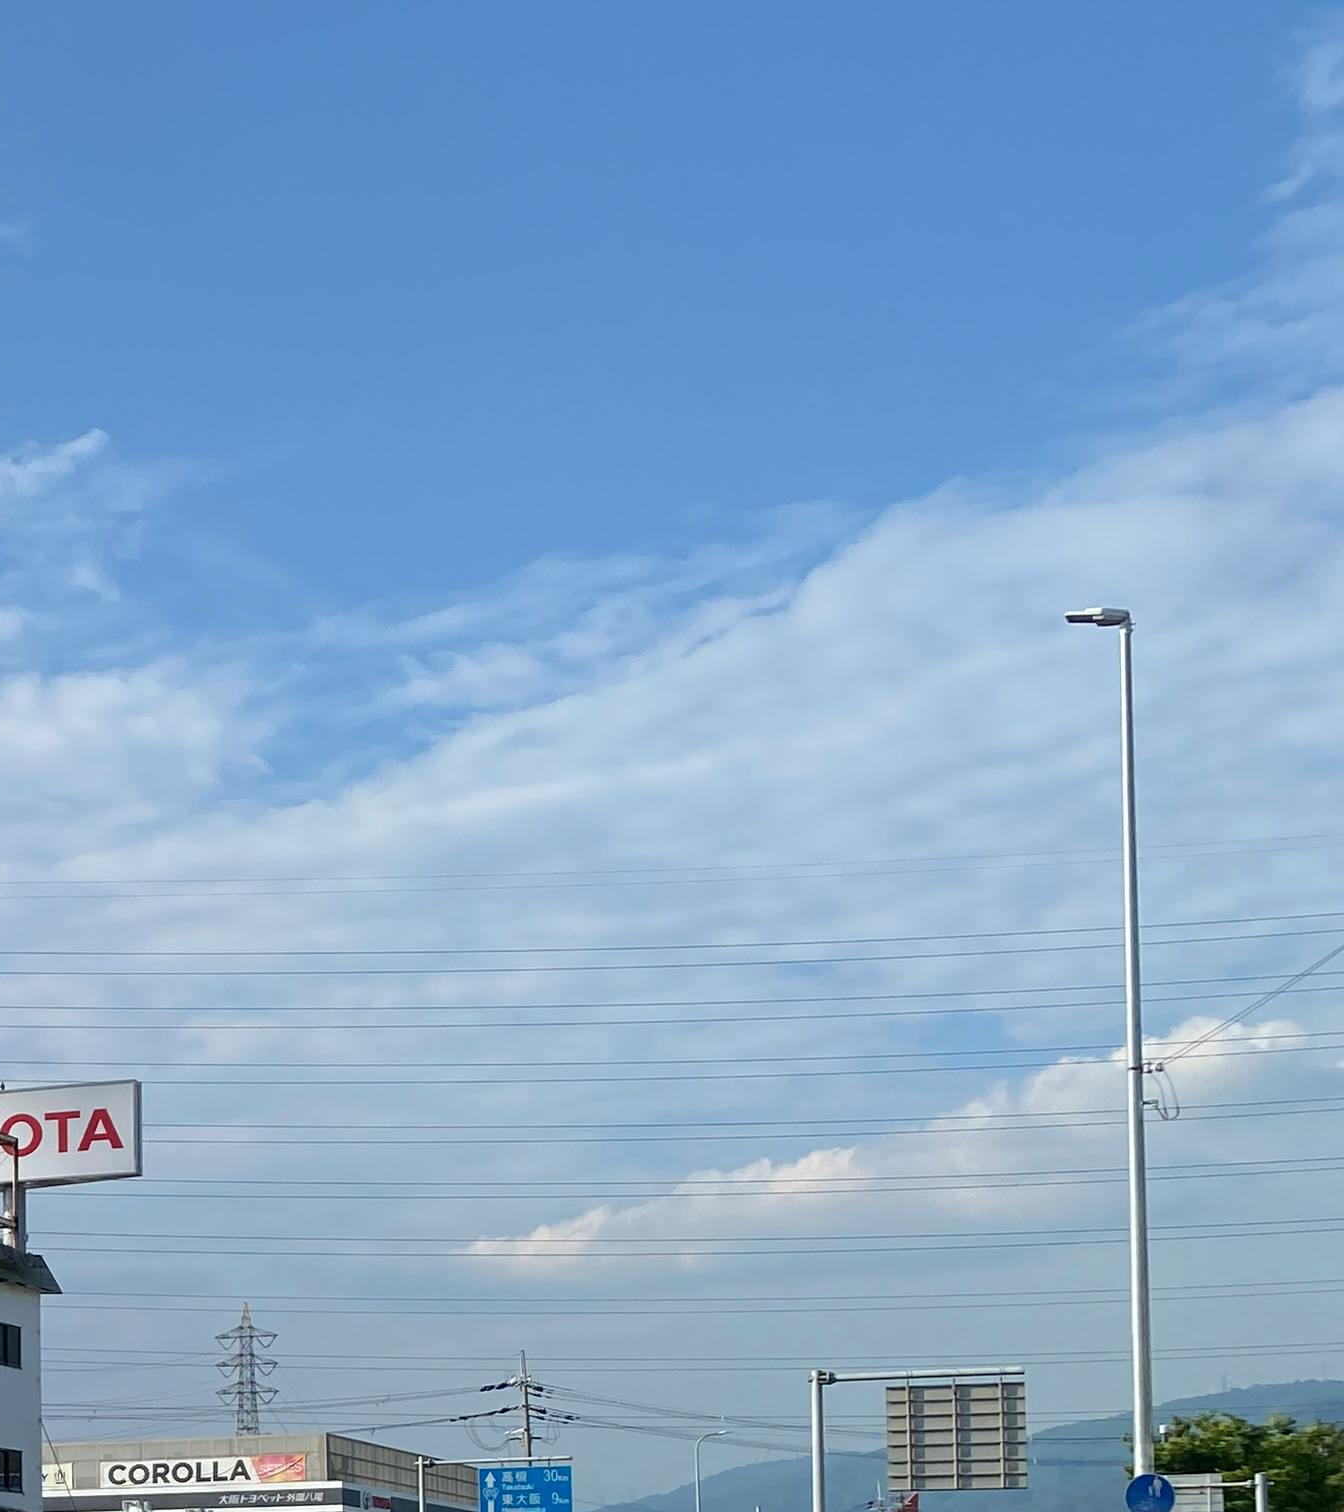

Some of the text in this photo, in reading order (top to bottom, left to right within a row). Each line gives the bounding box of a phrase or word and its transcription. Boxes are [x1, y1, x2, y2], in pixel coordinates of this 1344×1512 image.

[108, 1460, 251, 1486] COROLLA
[502, 1493, 541, 1505] 東大阪
